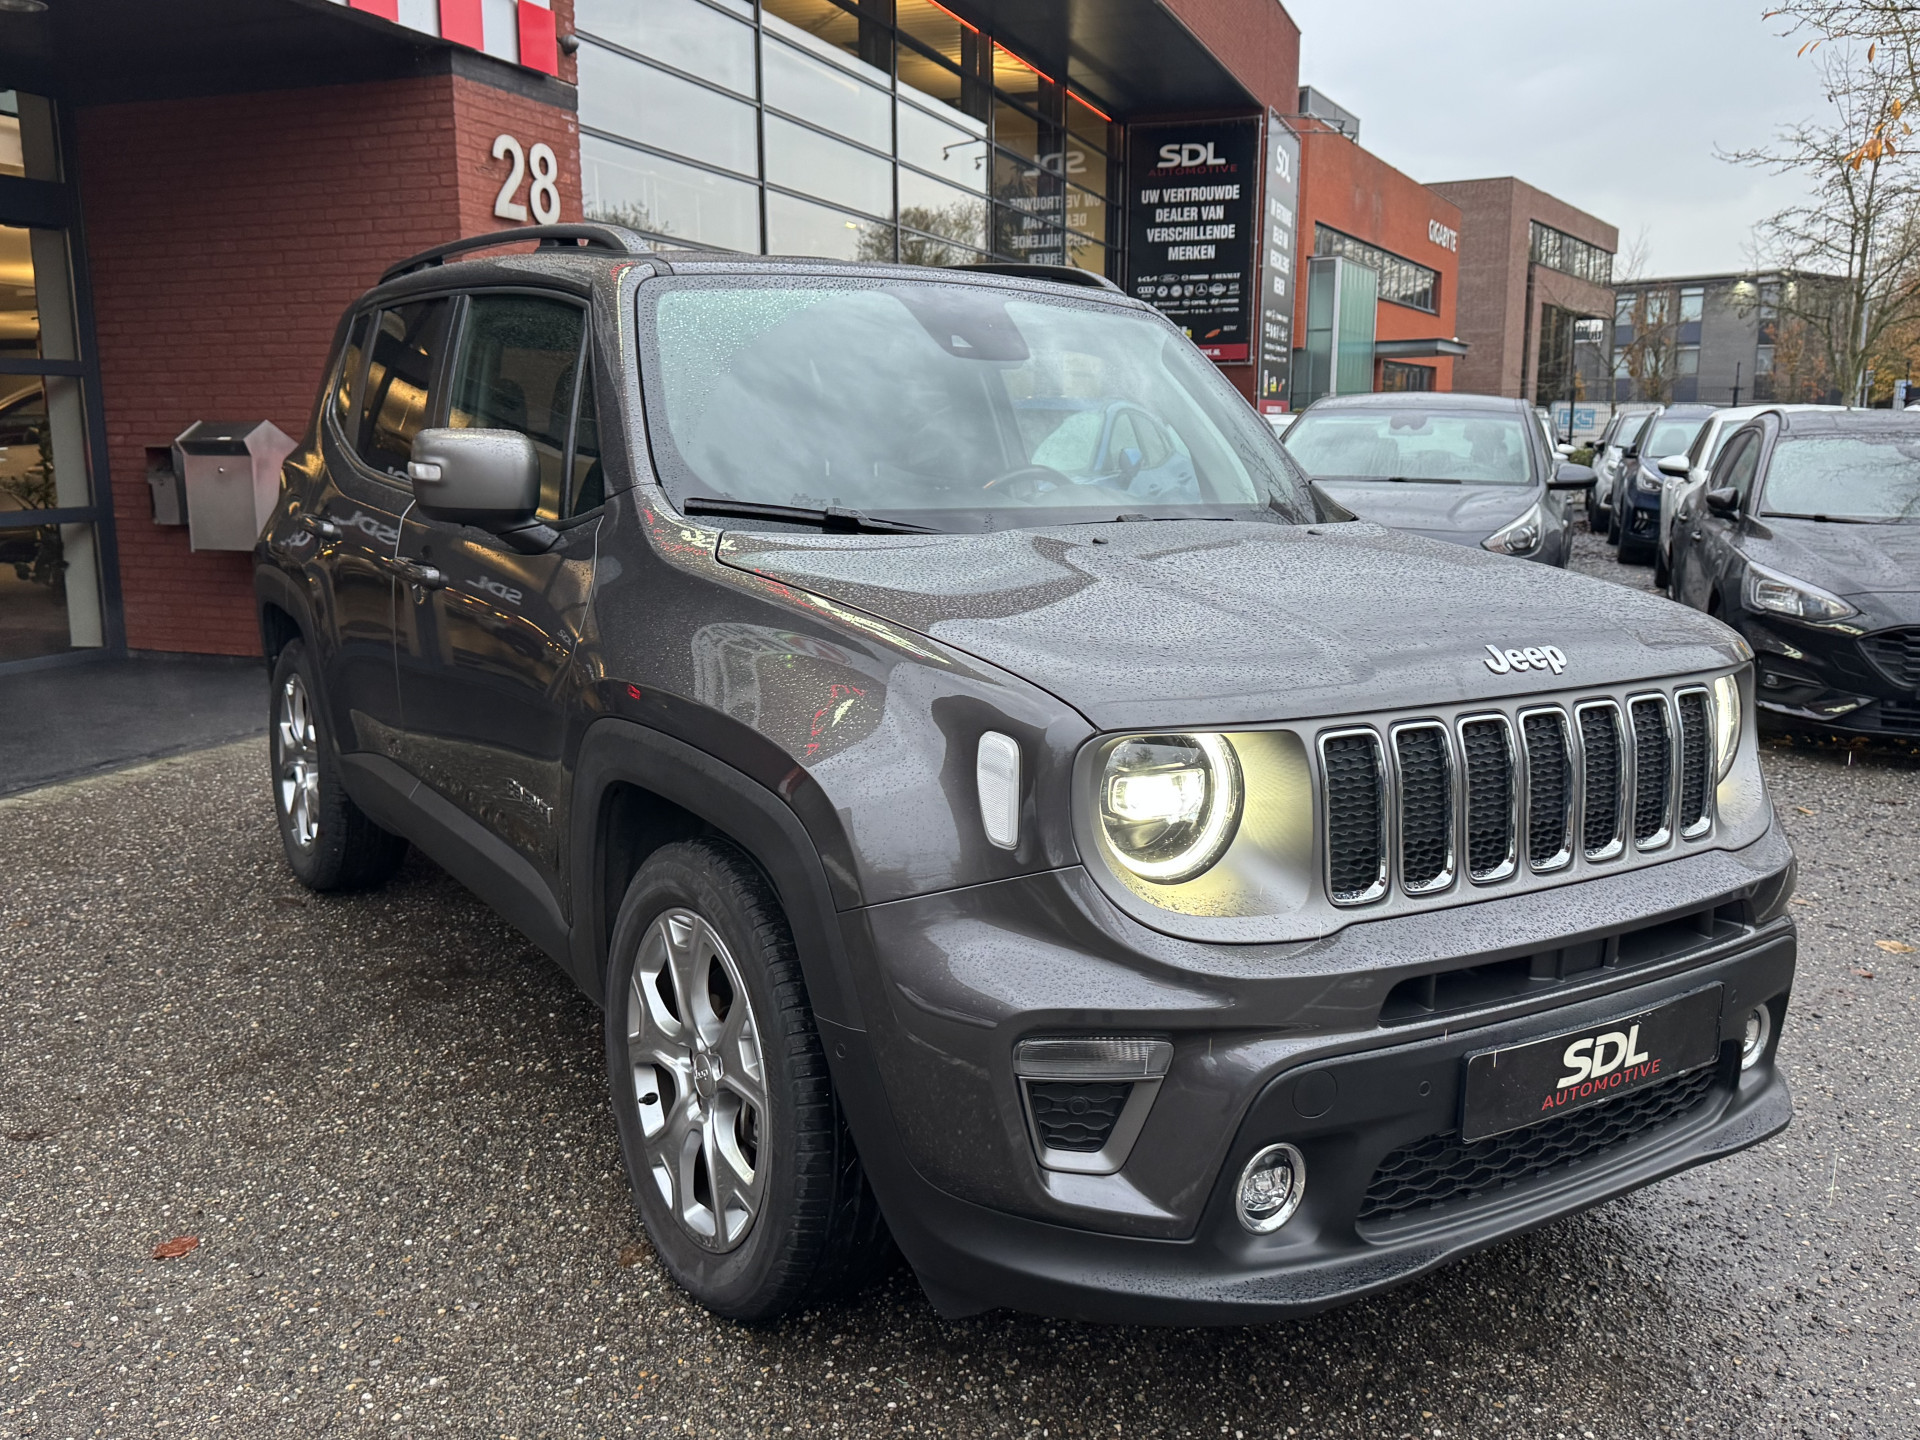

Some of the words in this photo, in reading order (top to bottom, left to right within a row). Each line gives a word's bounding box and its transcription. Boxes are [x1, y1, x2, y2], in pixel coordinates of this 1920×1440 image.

[1157, 142, 1226, 168] SDL
[492, 133, 561, 225] 28
[1148, 164, 1238, 177] AUTOMOTIVE
[1141, 189, 1160, 204] UW
[1162, 184, 1240, 203] VERTROUWDE
[1155, 207, 1199, 223] DEALER
[1201, 205, 1225, 221] VAN
[1146, 224, 1236, 243] VERSCHILLENDE
[1168, 244, 1216, 261] MERKEN
[1484, 645, 1568, 675] Jeep
[1556, 1024, 1649, 1089] SDL
[1541, 1059, 1661, 1111] AUTOMOTIVE
